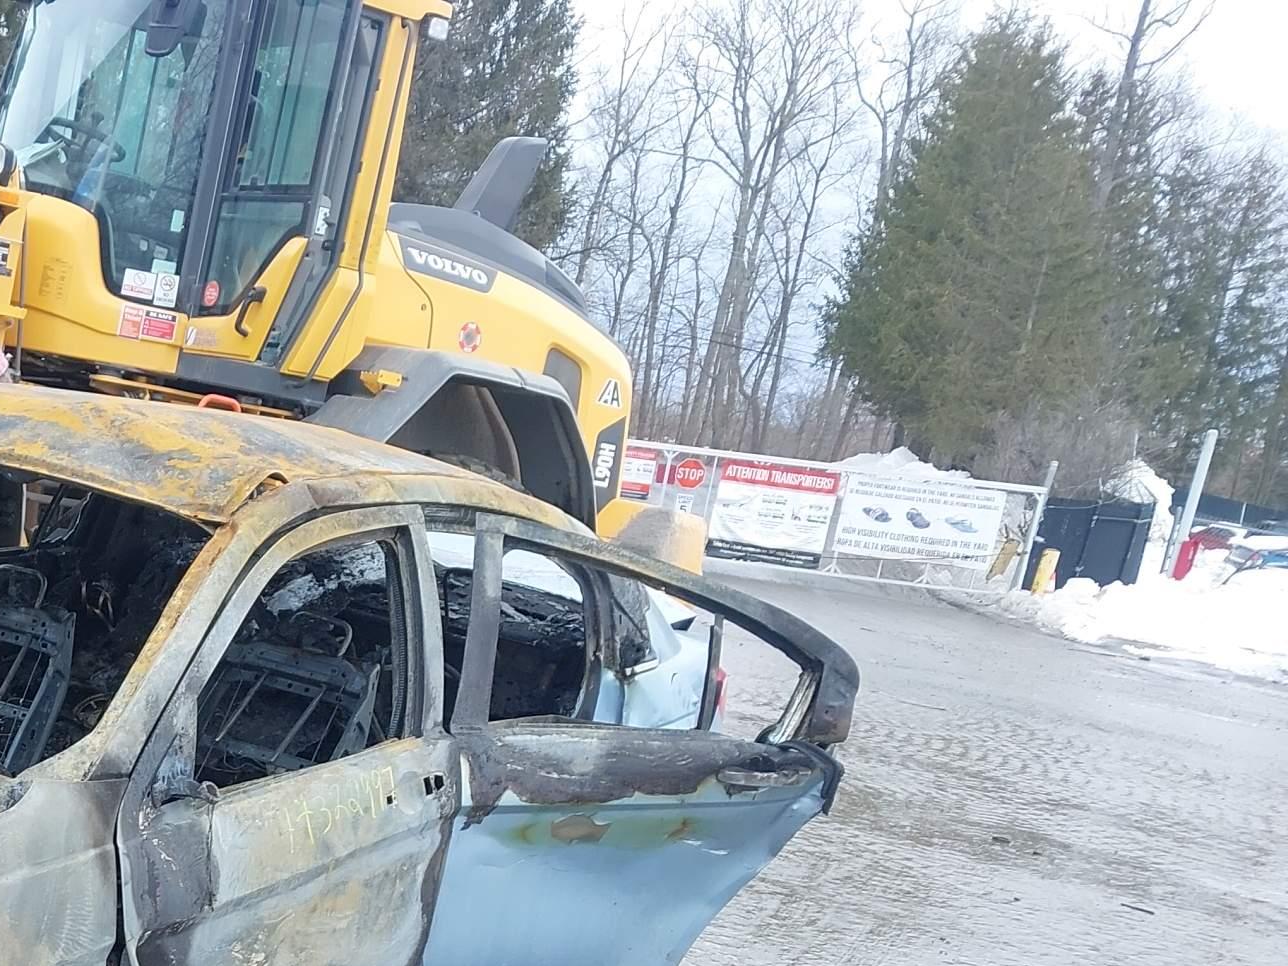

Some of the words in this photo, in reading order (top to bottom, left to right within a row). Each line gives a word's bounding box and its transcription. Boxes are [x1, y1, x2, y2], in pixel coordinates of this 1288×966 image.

[407, 247, 489, 285] VOLVO
[595, 442, 618, 488] L90H
[677, 468, 704, 481] STOP
[726, 464, 770, 481] ATTENTION
[771, 470, 835, 489] TRANSPORTERS!
[853, 540, 862, 548] DE
[863, 541, 879, 550] ALTA
[880, 543, 916, 554] VISIBILIDAD
[857, 528, 889, 539] VISIBILITY
[889, 532, 919, 542] CLOTHING
[920, 536, 950, 547] REQUIRED
